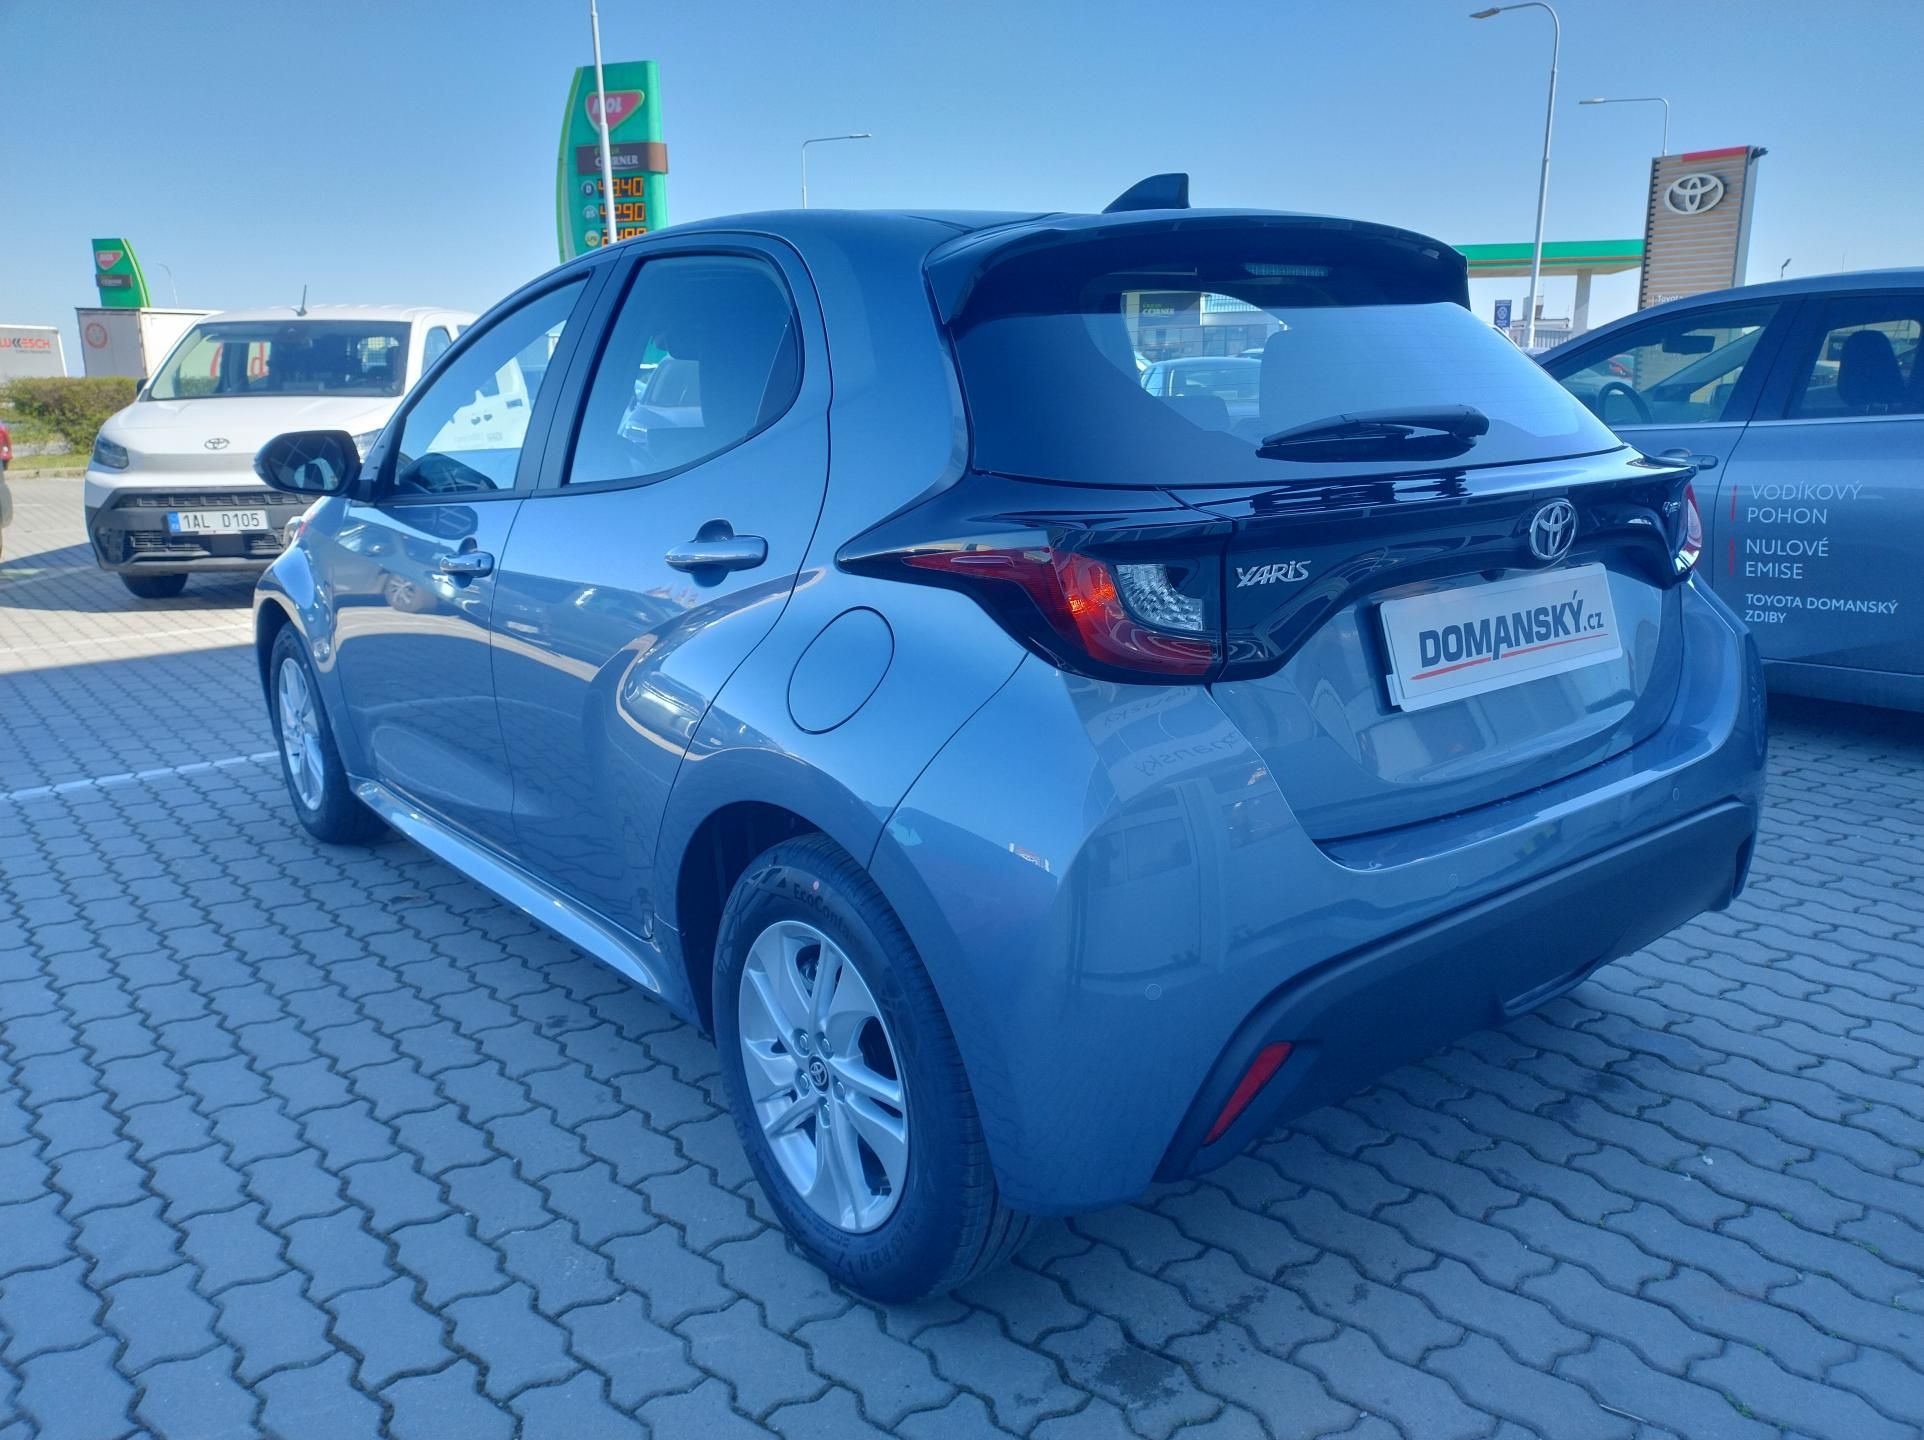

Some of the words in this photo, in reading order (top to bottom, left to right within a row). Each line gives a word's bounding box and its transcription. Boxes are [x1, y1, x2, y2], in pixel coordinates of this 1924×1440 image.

[1751, 479, 1863, 501] VODÍKOVÝ
[182, 514, 211, 529] 1AL
[222, 512, 260, 528] D105
[1747, 507, 1828, 525] POHON
[1746, 537, 1830, 557] NULOVÉ
[1235, 560, 1312, 588] YARIS
[1746, 561, 1804, 580] EMISE
[1745, 593, 1803, 609] TOYOTA
[1806, 597, 1899, 615] DOMANSKÝ
[1744, 609, 1787, 624] ZDIBY
